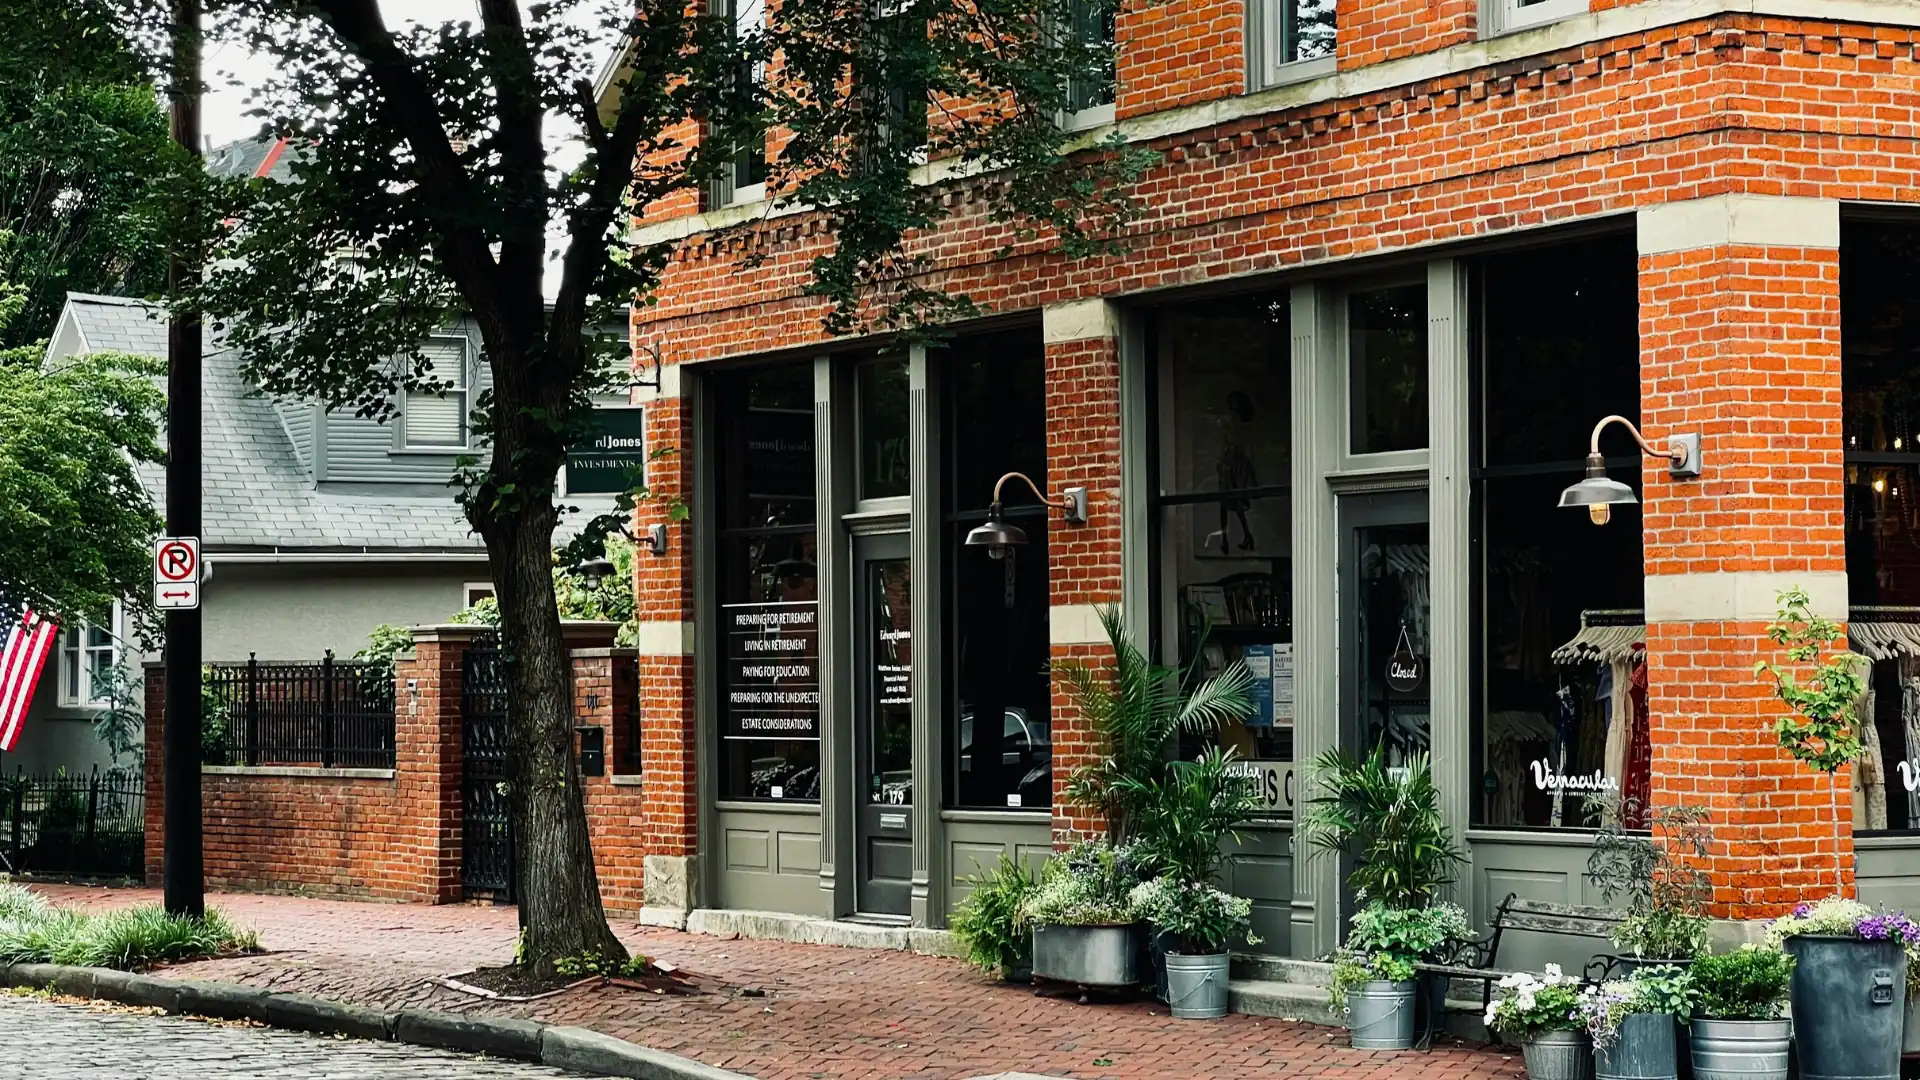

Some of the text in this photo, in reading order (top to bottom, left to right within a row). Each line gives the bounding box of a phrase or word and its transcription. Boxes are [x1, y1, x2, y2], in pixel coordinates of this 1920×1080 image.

[574, 459, 636, 469] INVESTMENTS
[736, 612, 815, 625] PREPARING FOR RETIREMENT
[744, 639, 807, 652] LIVING IN RETIREMENT
[742, 665, 810, 677] PAYING FOR EDUCATION
[1391, 662, 1417, 678] Closed
[730, 692, 761, 704] PREPARING
[761, 692, 773, 704] FOR
[773, 692, 785, 703] THE
[741, 718, 812, 730] ESTATE CONSIDERATIONS
[1530, 757, 1619, 791] Vernacular
[890, 790, 904, 805] 179
